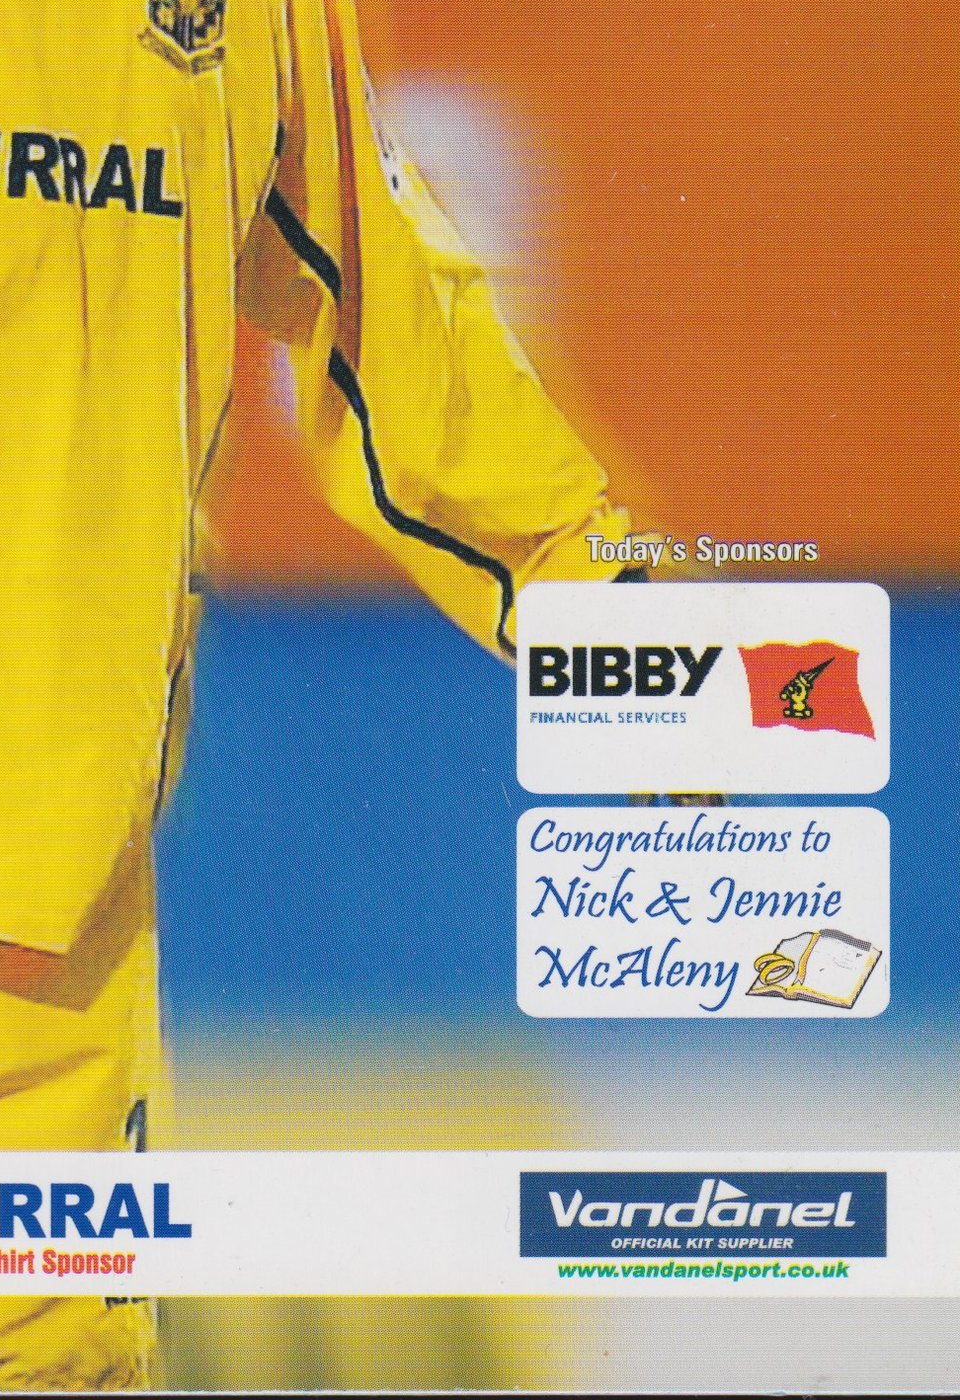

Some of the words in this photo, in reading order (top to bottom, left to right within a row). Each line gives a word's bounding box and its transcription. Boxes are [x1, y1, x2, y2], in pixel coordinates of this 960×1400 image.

[586, 534, 687, 567] Today's
[696, 536, 819, 567] Sponsors
[529, 646, 723, 697] BIBBY
[529, 712, 613, 724] FINANCIAL
[618, 712, 687, 724] SERVICES
[530, 813, 792, 872] Congratulations
[801, 820, 831, 853] to
[531, 867, 638, 924] Nick
[645, 882, 692, 926] &
[706, 876, 842, 924] Jennie
[534, 937, 739, 1012] McAleny
[548, 1178, 856, 1228] Vandanel
[42, 1249, 136, 1278] Sponsor
[611, 1237, 681, 1249] OFFICIAL
[686, 1237, 714, 1249] KIT
[717, 1237, 794, 1249] SUPPLIER
[558, 1260, 849, 1283] www.vandanelsport.co.uk
